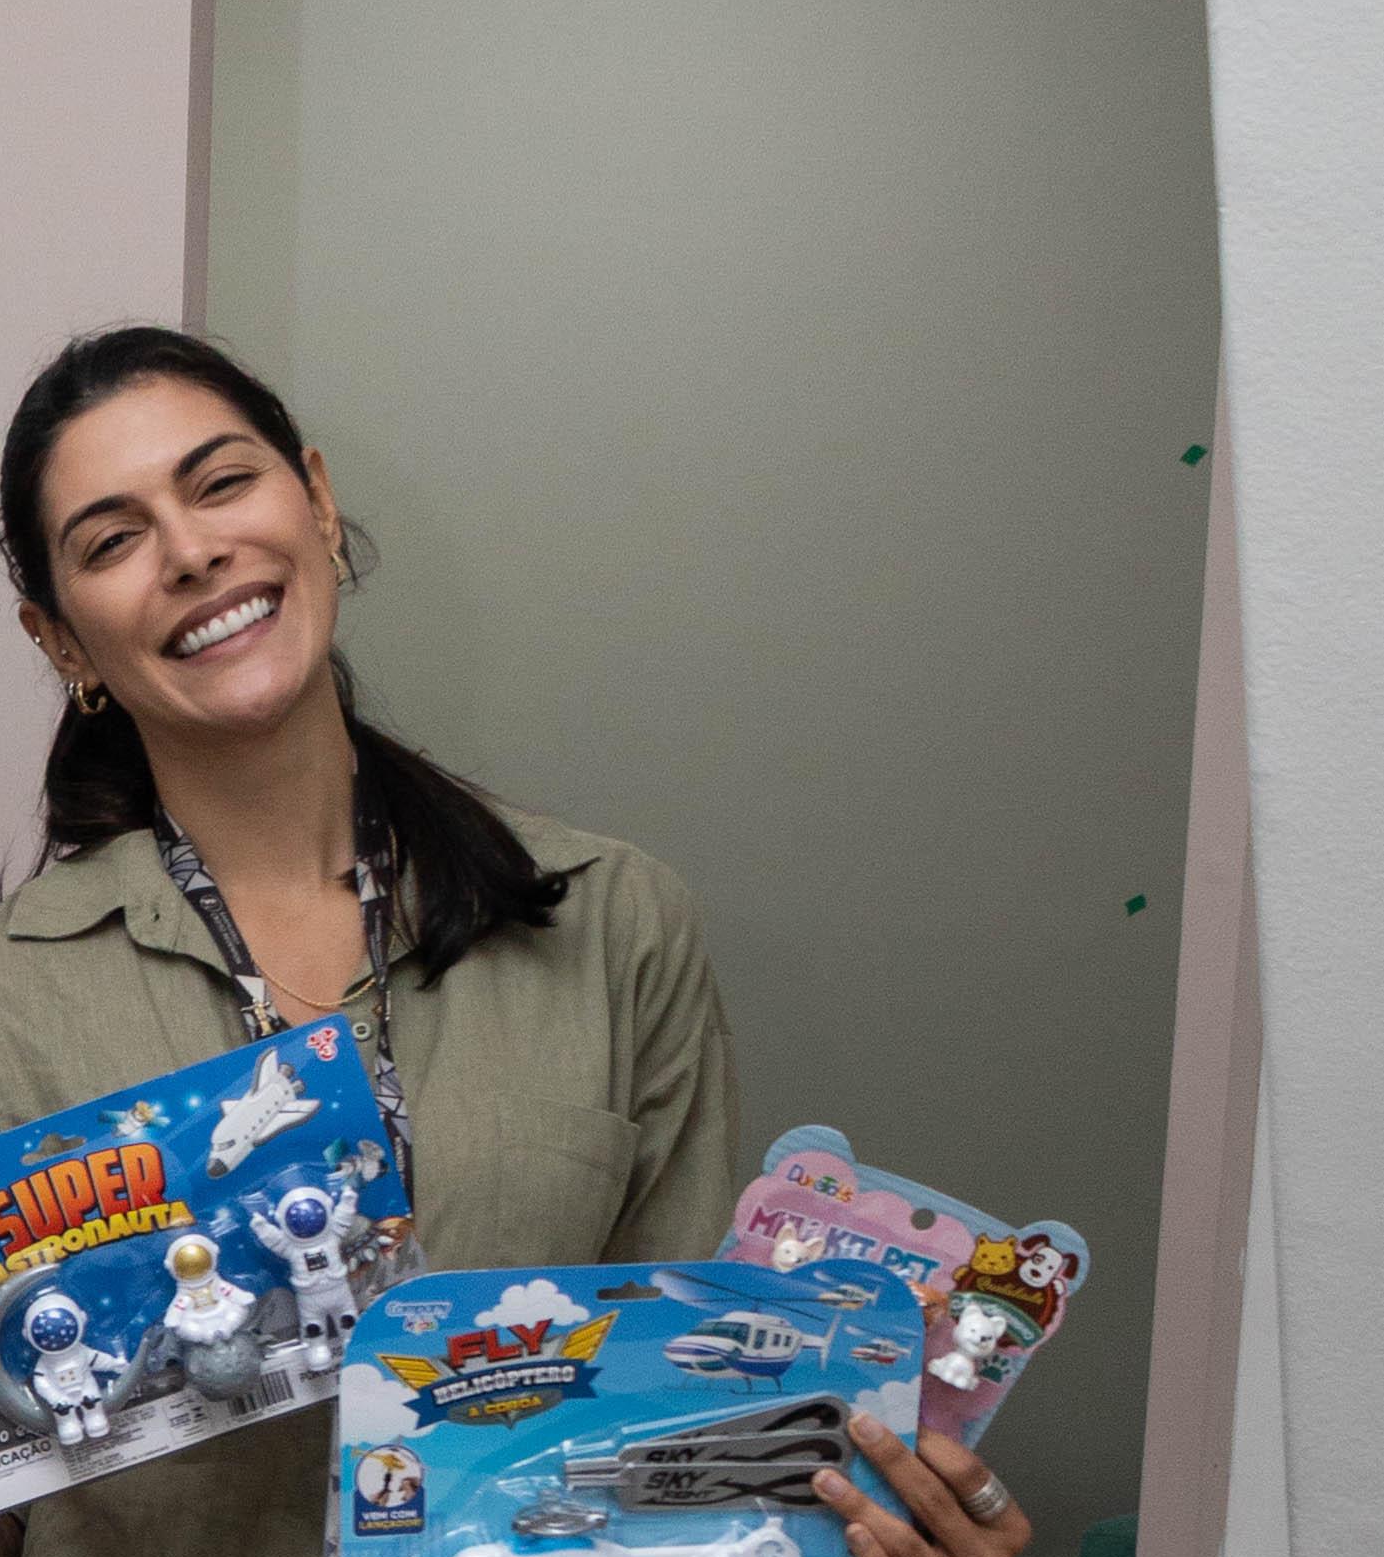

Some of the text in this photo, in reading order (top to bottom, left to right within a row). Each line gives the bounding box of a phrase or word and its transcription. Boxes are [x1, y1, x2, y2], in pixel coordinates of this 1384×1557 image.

[445, 1317, 555, 1371] FLY
[432, 1364, 577, 1406] HELICÓPTERO
[643, 1470, 711, 1491] SKY
